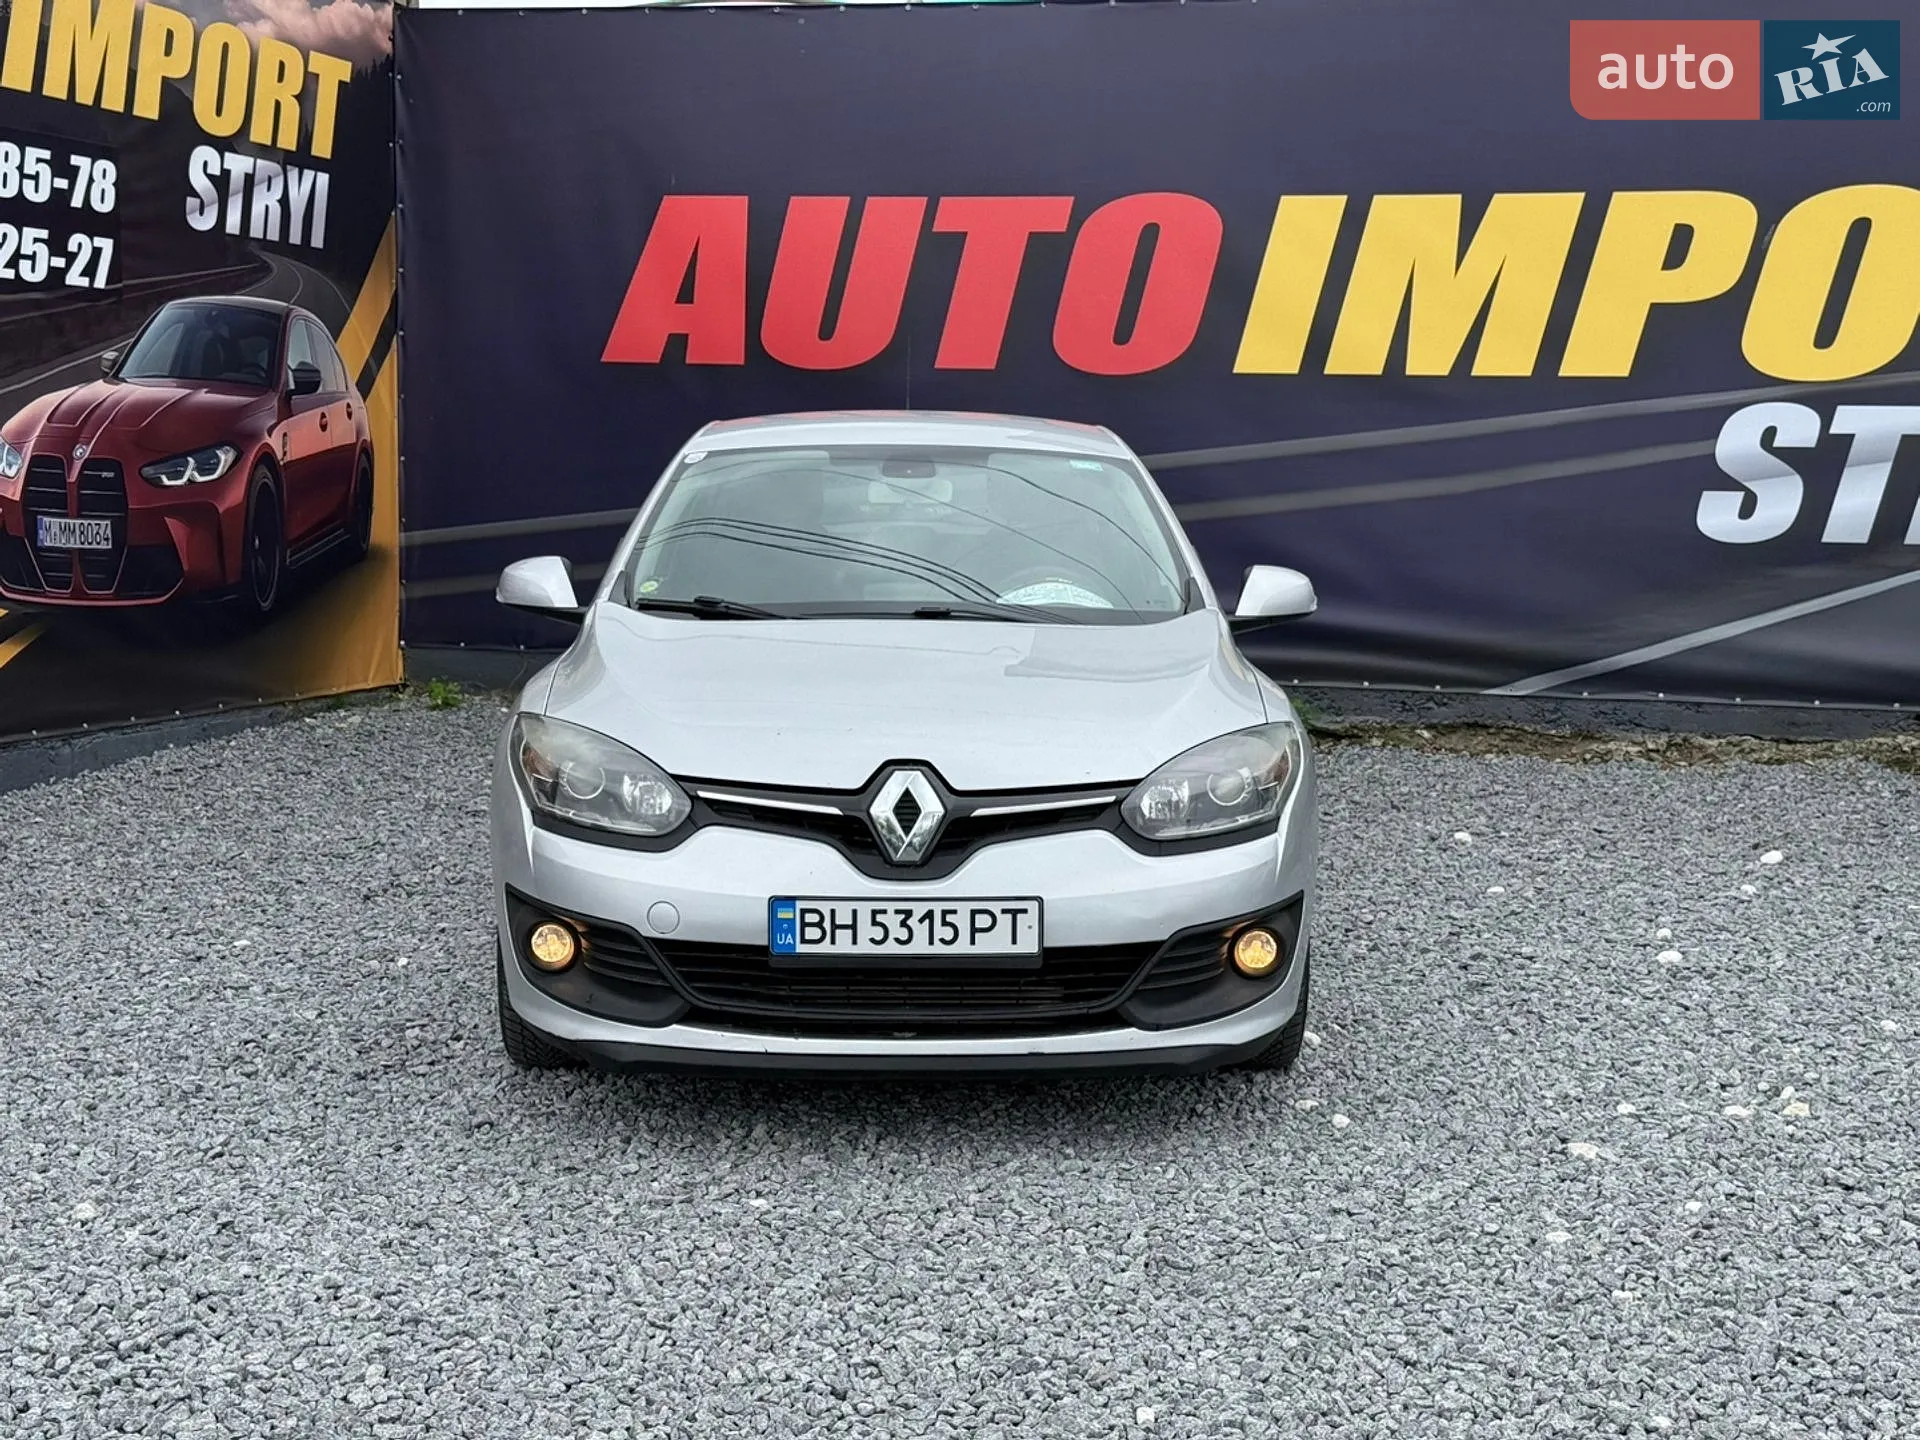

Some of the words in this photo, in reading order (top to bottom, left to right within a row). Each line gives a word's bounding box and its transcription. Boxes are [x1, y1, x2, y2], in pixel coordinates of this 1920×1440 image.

[1, 0, 352, 160] IMPORT
[185, 145, 330, 249] STRYI
[600, 192, 1224, 376] AUTO
[1696, 402, 1920, 545] ST
[777, 933, 795, 946] UA
[800, 908, 858, 946] BH
[868, 908, 960, 946] 5315
[969, 907, 1029, 946] PT
